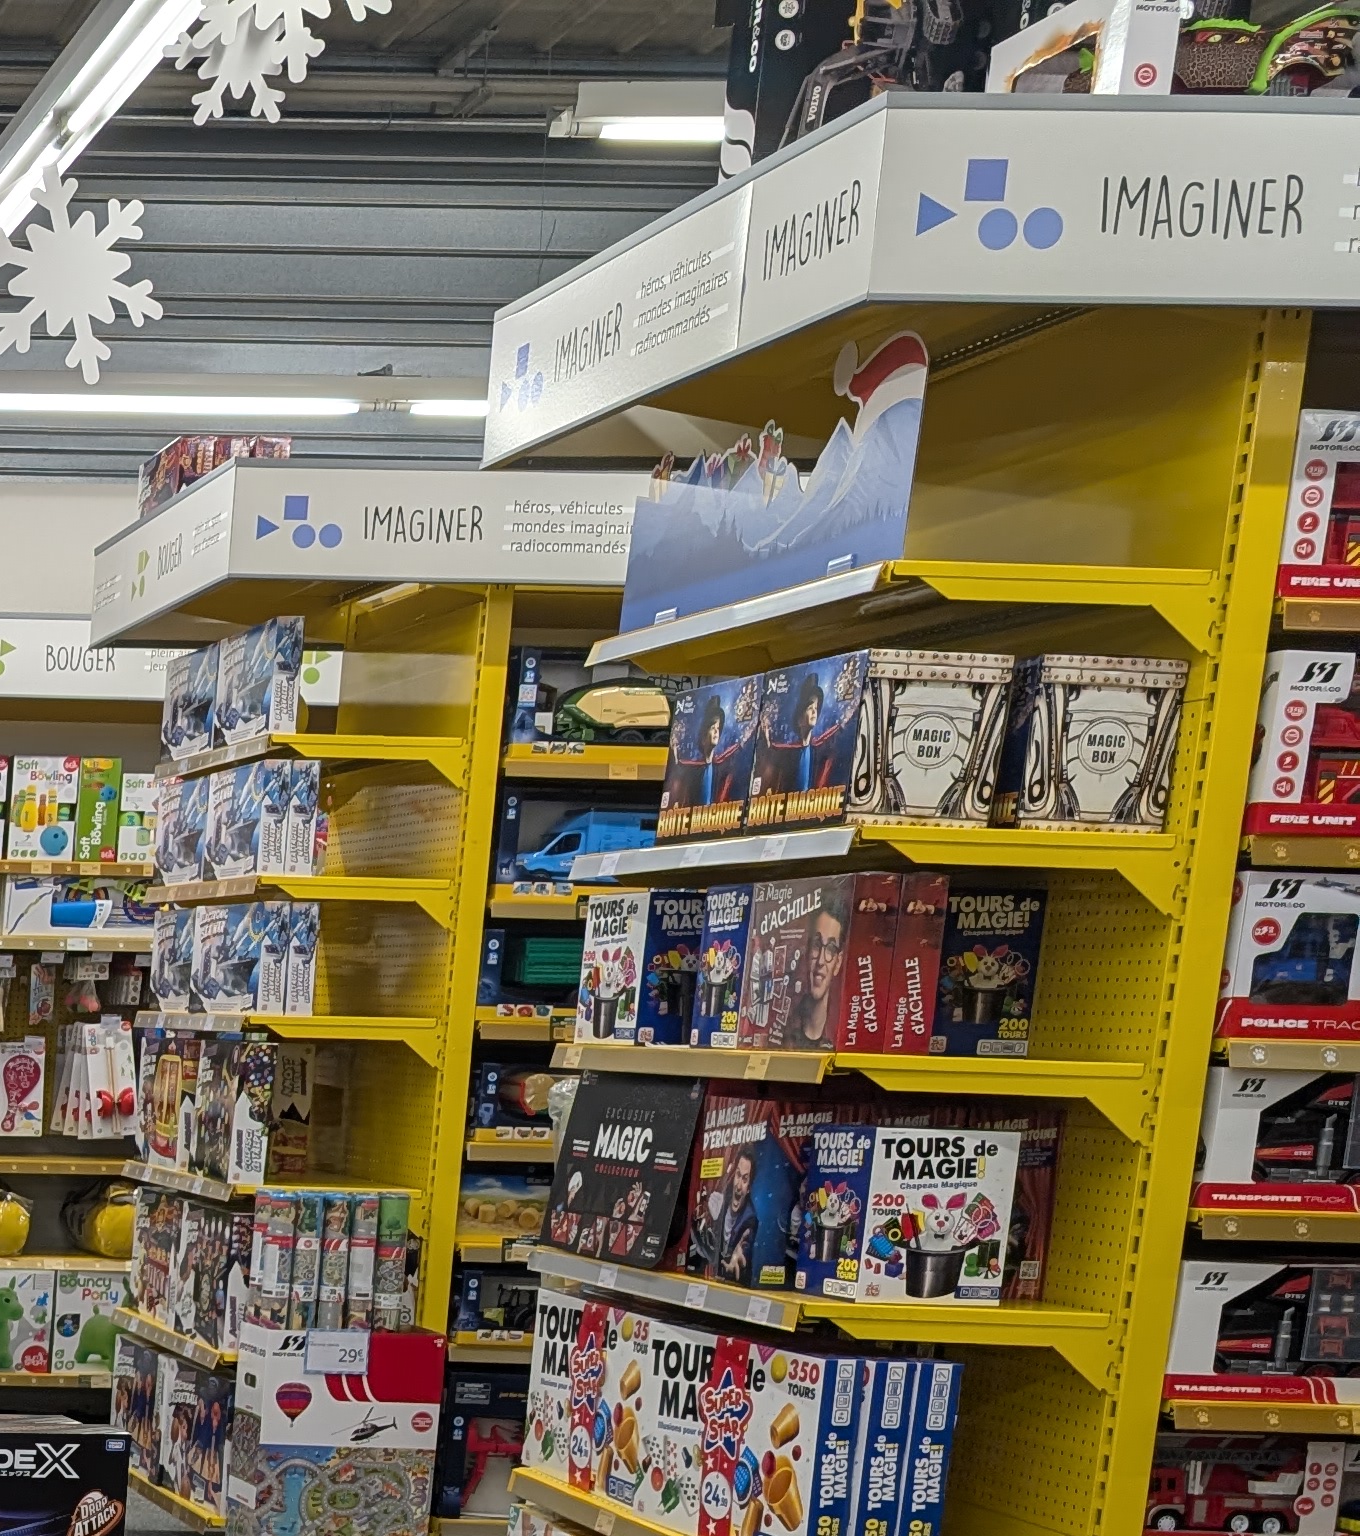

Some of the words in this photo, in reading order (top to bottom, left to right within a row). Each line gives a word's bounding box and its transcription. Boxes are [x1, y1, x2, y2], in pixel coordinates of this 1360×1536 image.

[806, 84, 822, 123] VOLVO
[1100, 174, 1305, 240] IMAGINER
[762, 179, 862, 282] IMAGINER
[640, 275, 669, 300] héros,
[668, 248, 713, 285] véhicules
[636, 294, 673, 327] mondes
[674, 270, 729, 310] imaginaires
[554, 302, 623, 384] IMAGINER
[634, 308, 711, 355] radiocommandés
[513, 500, 555, 516] héros,
[559, 500, 623, 515] véhicules
[363, 506, 483, 543] IMAGINER
[511, 520, 566, 535] mondes
[509, 539, 627, 555] radiocommandés
[912, 728, 951, 743] MAGIC
[917, 743, 942, 759] BOX
[748, 795, 783, 826] BOÎTE
[785, 788, 845, 822] MAGIQUE
[760, 887, 822, 937] d'ACHILLE
[949, 896, 1015, 914] TOURS
[1017, 898, 1040, 912] de
[956, 910, 1030, 929] MAGIE!
[997, 1017, 1029, 1032] 200
[997, 1030, 1028, 1039] TOURS
[1240, 1017, 1310, 1030] POLICE
[605, 1108, 657, 1123] EXCLUSIVE
[593, 1123, 654, 1164] MAGIC
[881, 1136, 966, 1160] TOURS
[973, 1139, 998, 1158] de
[891, 1157, 986, 1181] MAGIE!
[899, 1181, 938, 1190] Chapeau
[938, 1180, 978, 1189] Magique
[871, 1193, 906, 1209] 200
[871, 1207, 903, 1217] TOURS
[787, 1357, 820, 1385] 350
[703, 1385, 744, 1415] SUPER
[787, 1383, 816, 1400] TOURS
[709, 1415, 745, 1442] STAR
[80, 1496, 108, 1519] DROP
